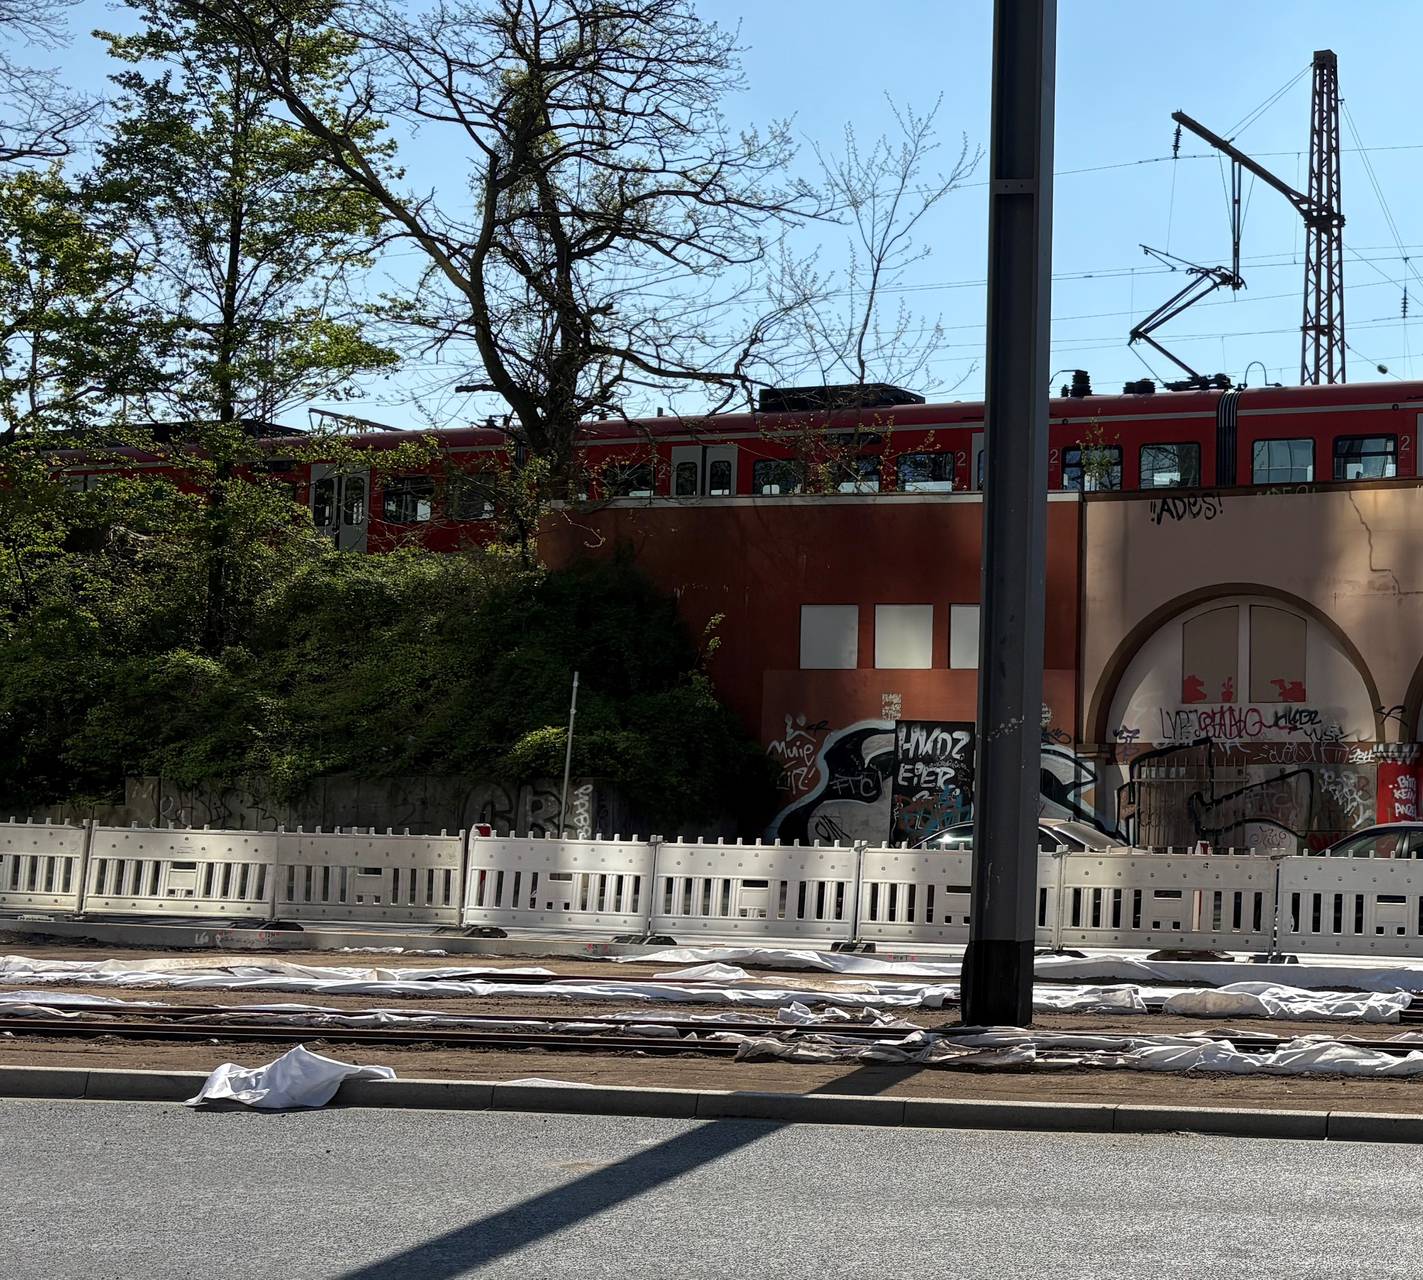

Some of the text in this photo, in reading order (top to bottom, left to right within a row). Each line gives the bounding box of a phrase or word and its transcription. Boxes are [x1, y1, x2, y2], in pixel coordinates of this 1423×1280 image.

[1400, 434, 1411, 451] 2
[956, 452, 967, 467] 2
[1049, 448, 1059, 465] 2
